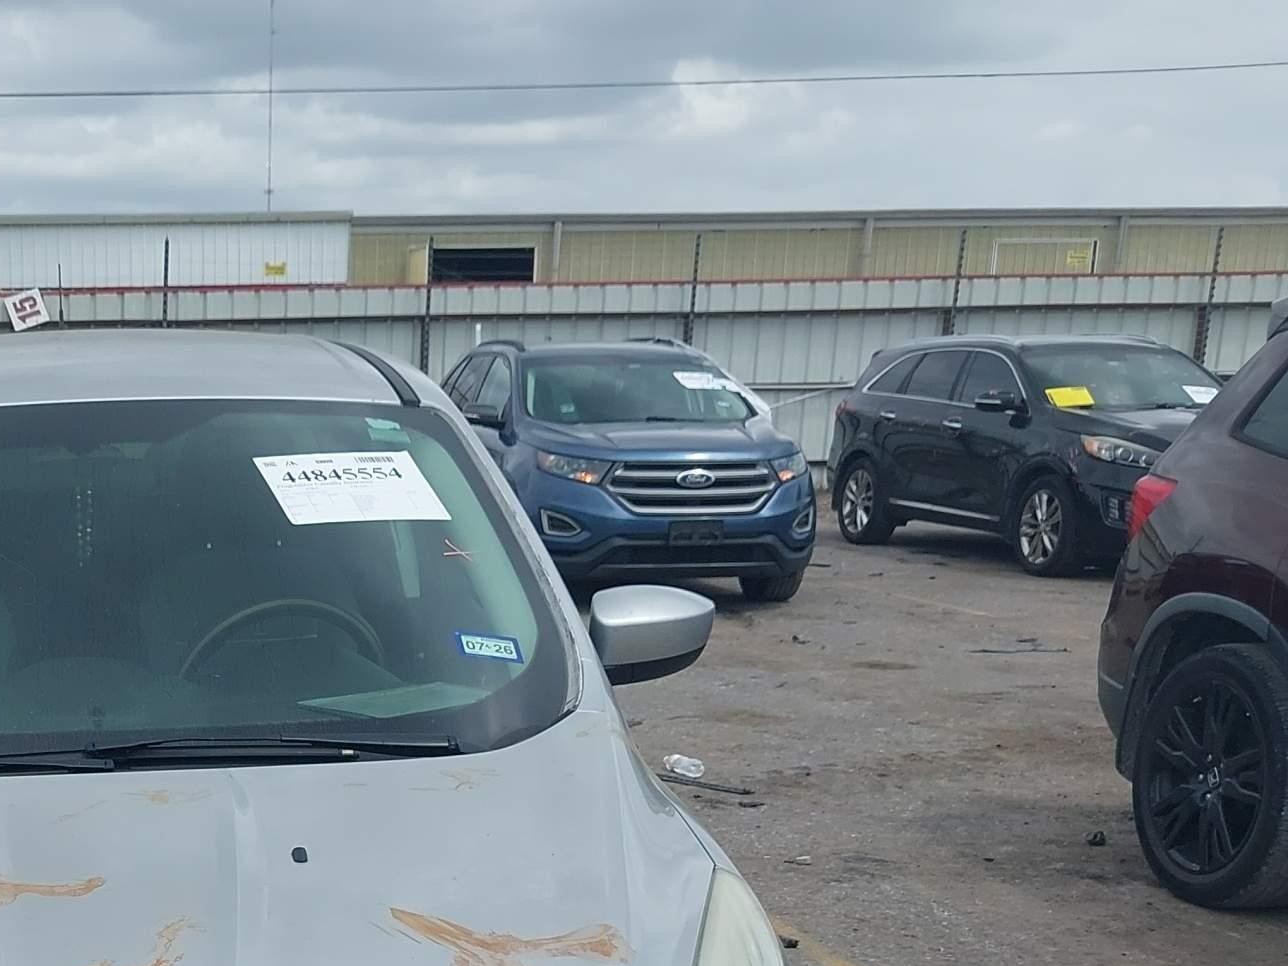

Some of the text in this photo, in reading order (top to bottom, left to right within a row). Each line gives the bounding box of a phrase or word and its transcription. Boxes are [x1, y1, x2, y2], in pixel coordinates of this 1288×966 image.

[12, 296, 42, 325] 15
[282, 467, 403, 483] 44845554
[465, 640, 514, 656] 07 26
